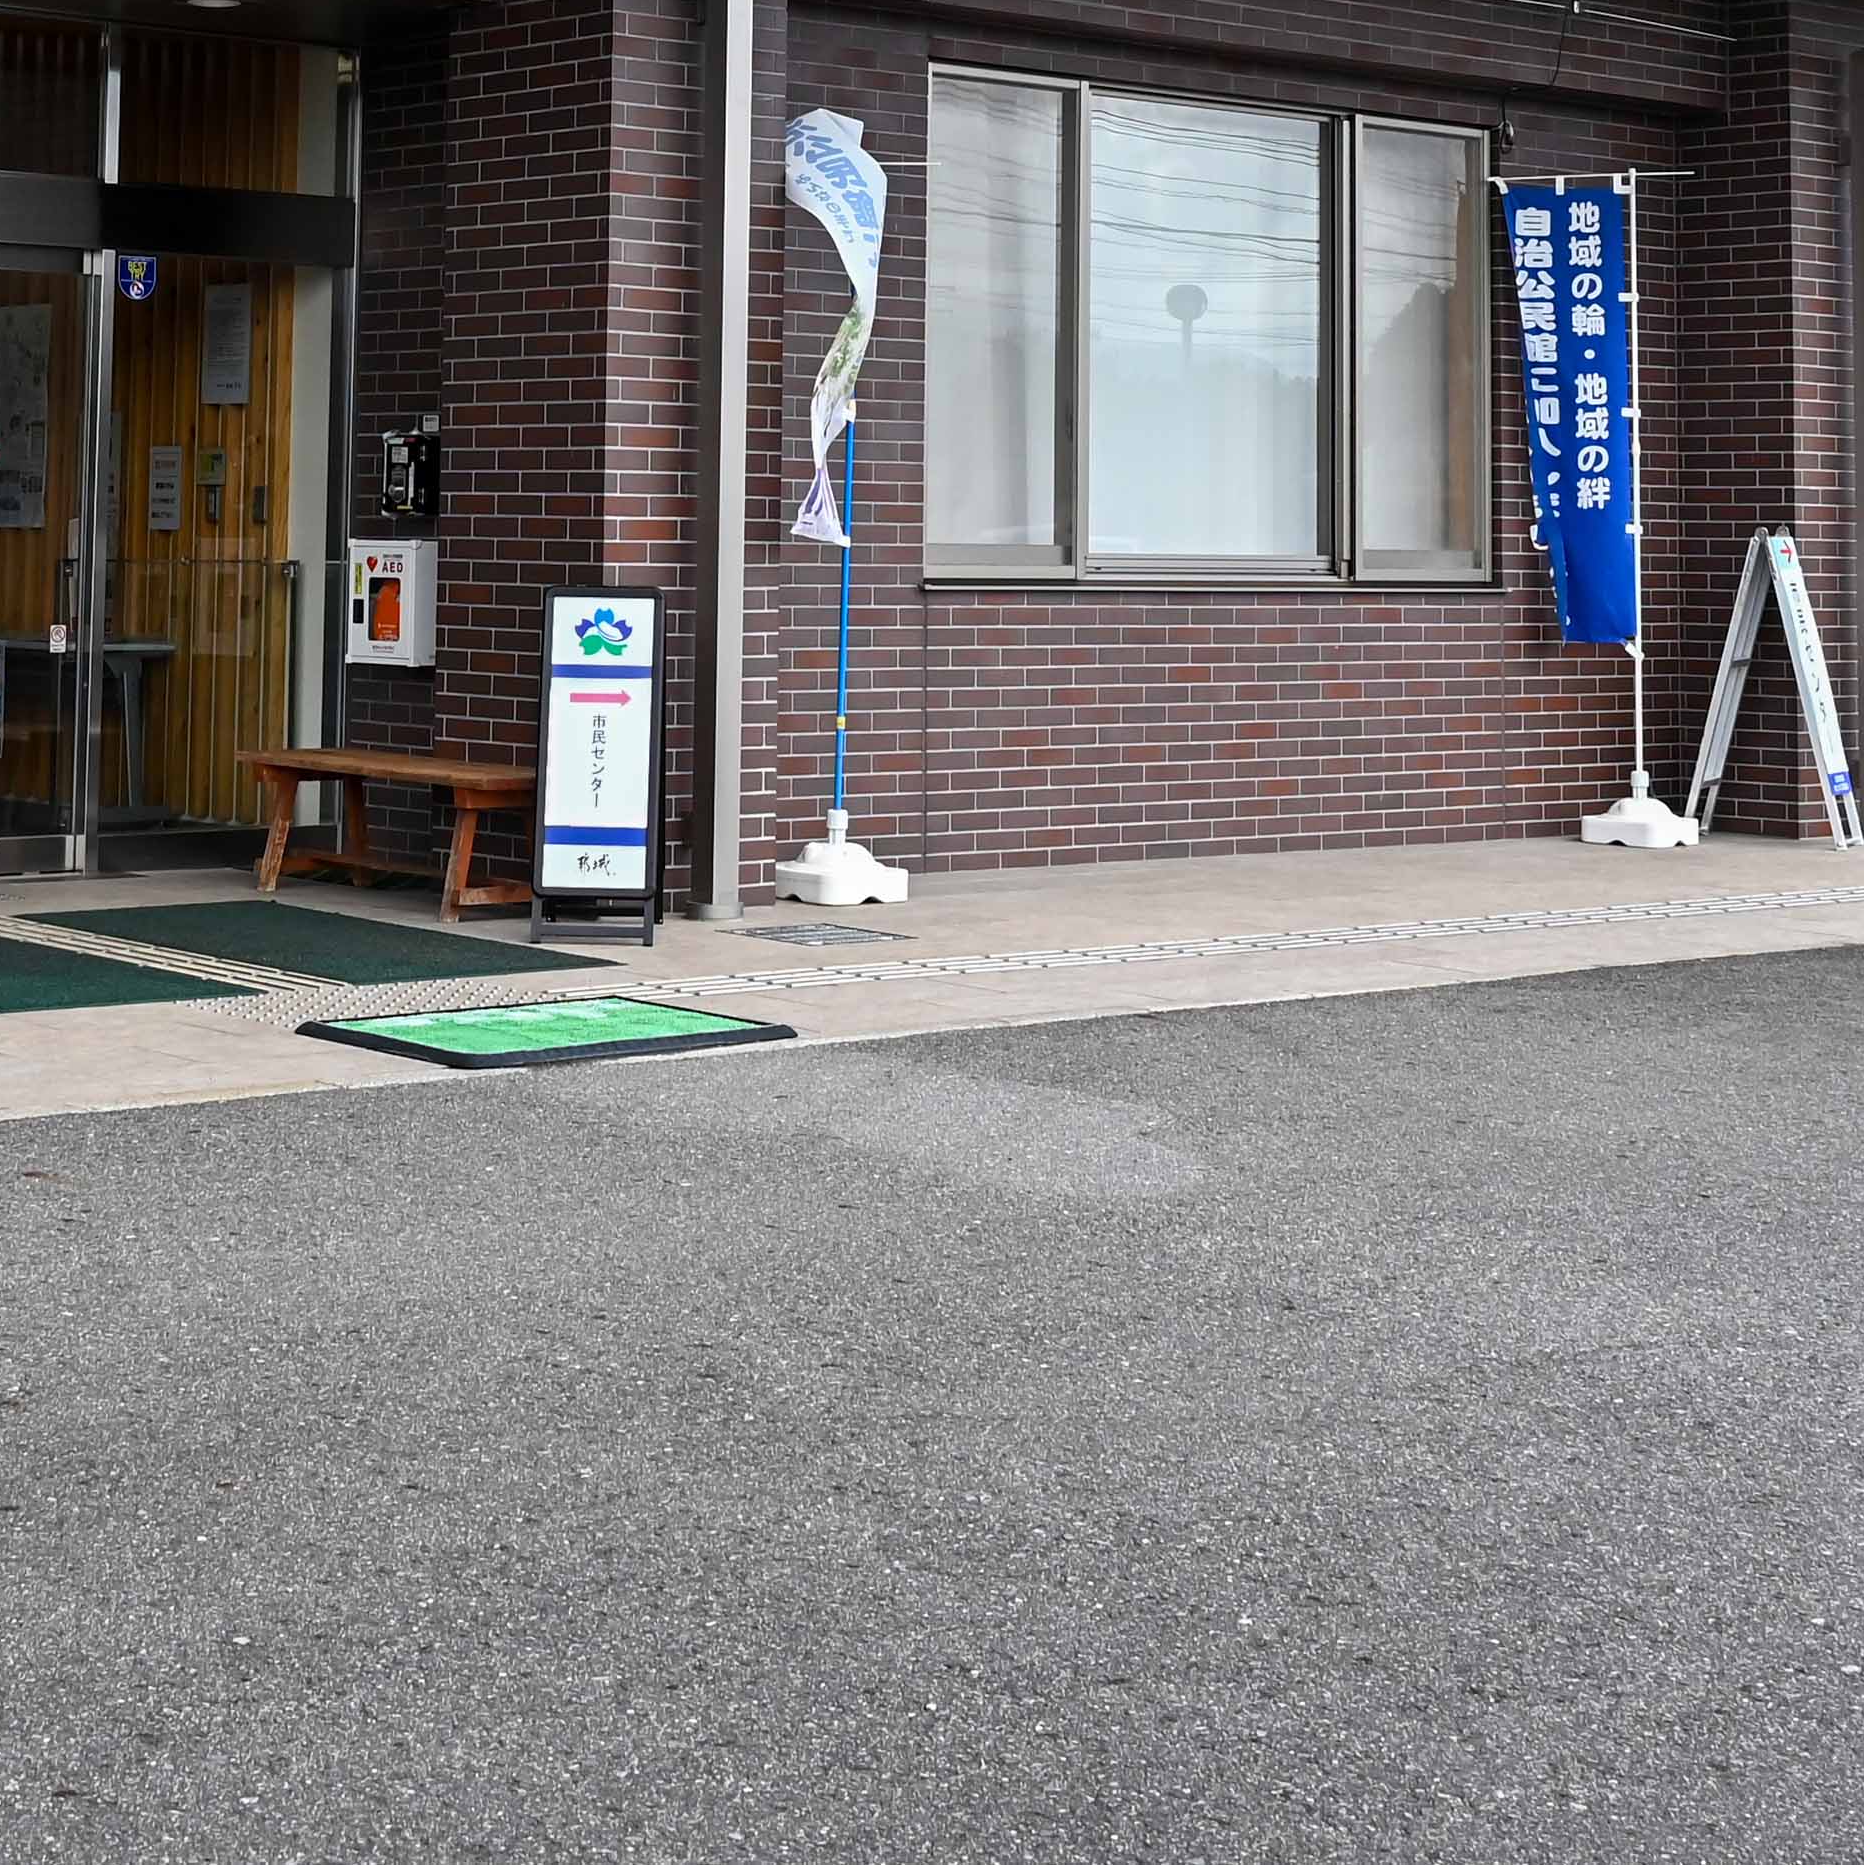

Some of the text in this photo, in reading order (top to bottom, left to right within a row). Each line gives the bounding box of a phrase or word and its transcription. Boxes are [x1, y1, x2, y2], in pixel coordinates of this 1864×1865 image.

[1568, 201, 1612, 510] 地域の輪・地域の絆
[382, 561, 403, 573] AED
[591, 714, 606, 808] 市民センター
